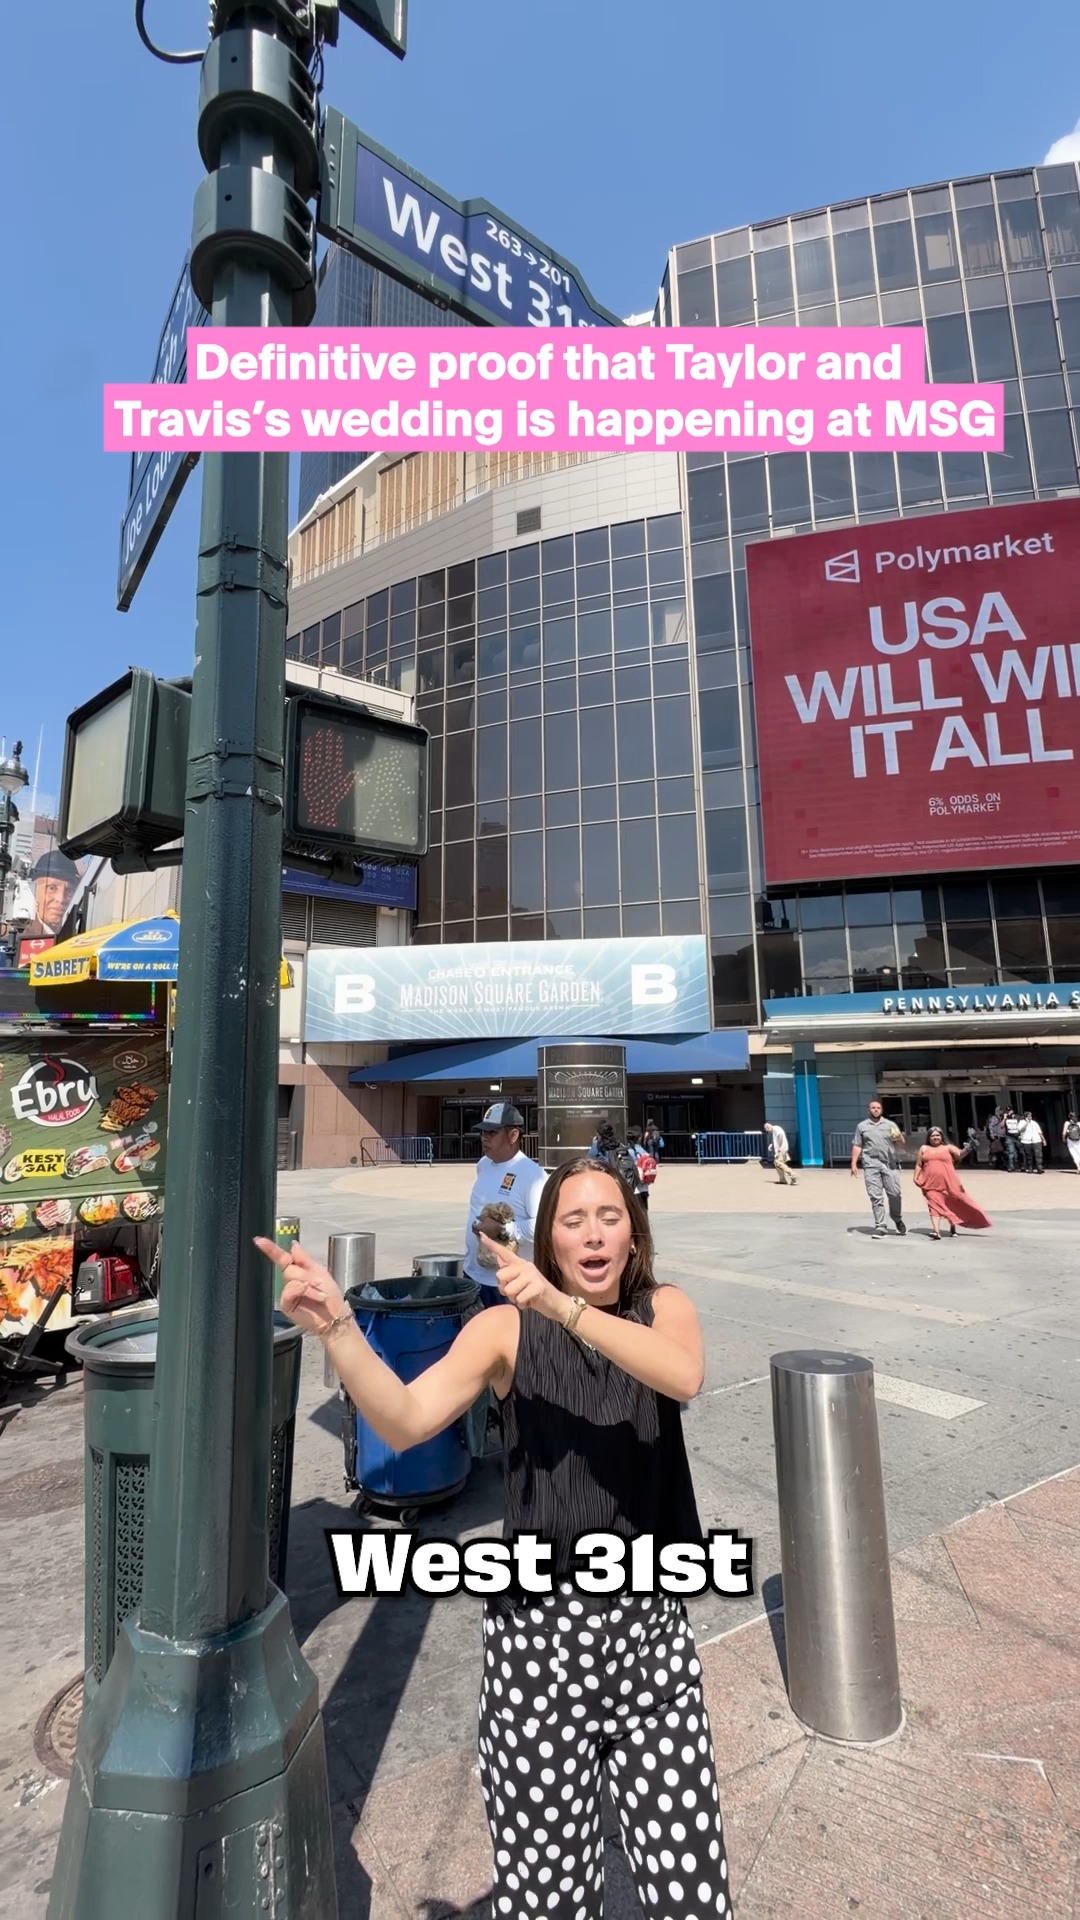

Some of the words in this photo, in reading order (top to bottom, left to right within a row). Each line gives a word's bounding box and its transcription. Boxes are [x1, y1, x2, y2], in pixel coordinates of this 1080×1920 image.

[382, 177, 513, 310] West
[486, 219, 522, 257] 263
[539, 258, 570, 293] 201
[125, 502, 143, 564] Joe
[875, 532, 1055, 574] Polymarket
[869, 591, 1027, 655] USA
[784, 658, 963, 724] WILL
[850, 720, 913, 779] IT
[930, 708, 1074, 772] ALL
[928, 797, 944, 807] 6%
[950, 793, 979, 805] ODDS
[985, 792, 1001, 803] ON
[928, 802, 1001, 816] POLYMARKET
[491, 964, 574, 977] ENTRANCE
[631, 964, 678, 1005] B
[335, 974, 376, 1014] B
[401, 984, 468, 1008] MADISON
[474, 981, 535, 1006] SQUARE
[539, 979, 601, 1003] GARDEN
[883, 991, 1060, 1012] PENNSYLVANIA
[10, 1076, 99, 1120] Ebru
